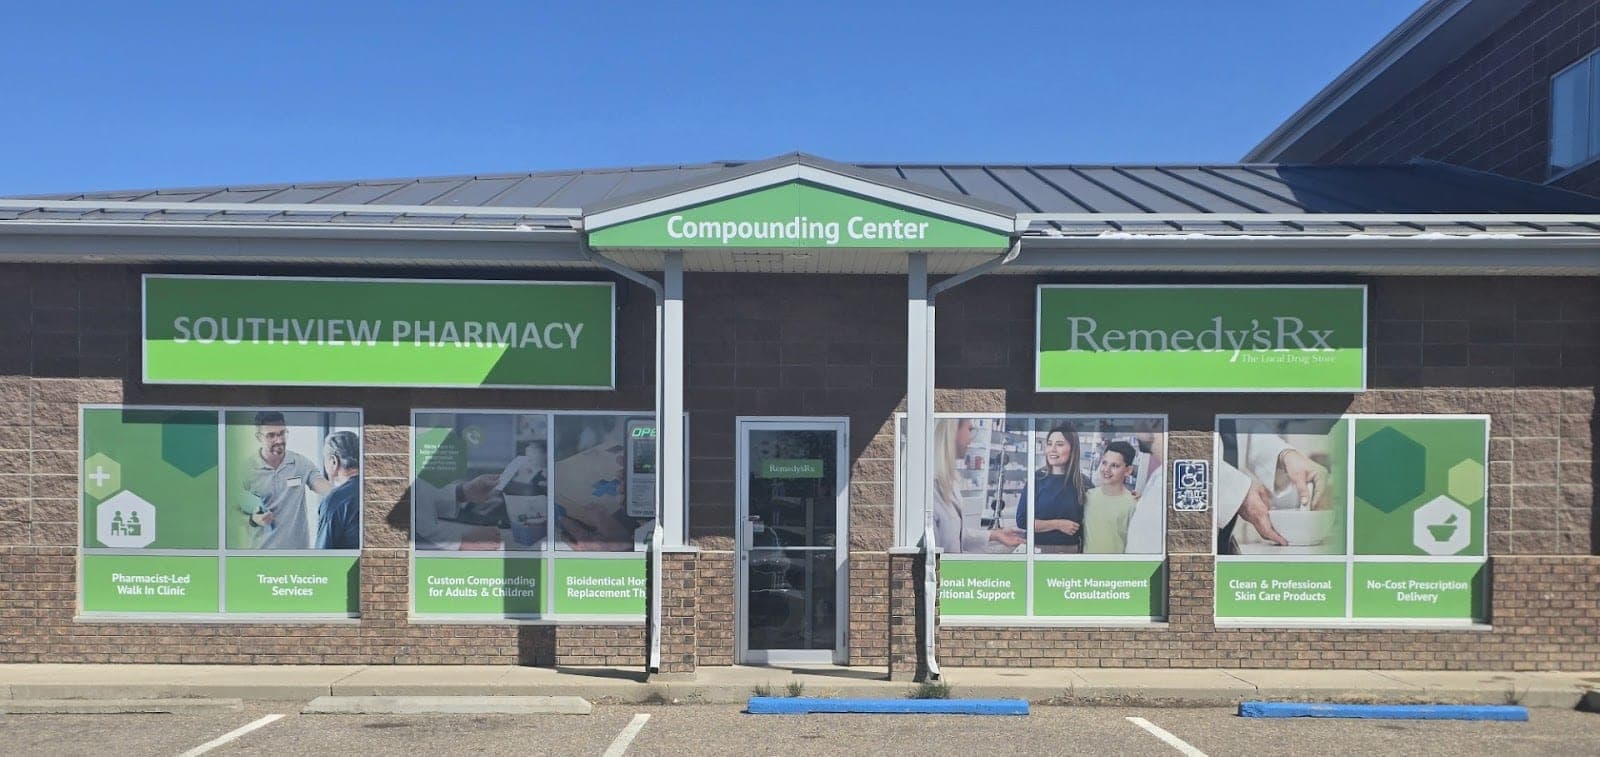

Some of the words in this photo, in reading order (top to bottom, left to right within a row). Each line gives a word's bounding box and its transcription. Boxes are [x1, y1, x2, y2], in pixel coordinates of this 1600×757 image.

[666, 215, 840, 246] Compounding
[847, 215, 929, 240] Center
[173, 316, 382, 347] SOUTHVIEW
[392, 320, 584, 350] PHARMACY
[1242, 354, 1258, 363] The
[1261, 354, 1285, 363] Local
[1287, 354, 1310, 365] Drug
[1311, 354, 1335, 363] Store
[632, 427, 657, 437] OPE
[112, 573, 191, 584] Pharmacist-Led
[257, 574, 288, 585] Travel
[290, 574, 329, 585] Vaccine
[427, 575, 465, 586] Custom
[467, 575, 536, 588] Compounding
[566, 576, 625, 587] Bioidentical
[627, 576, 648, 587] Hor
[939, 577, 965, 588] ional
[967, 577, 1011, 588] Medicine
[1047, 578, 1081, 590] Weight
[1083, 578, 1149, 591] Management
[1229, 579, 1258, 590] Clean
[1260, 579, 1269, 590] &
[1271, 579, 1332, 590] Professional
[1367, 580, 1407, 590] No-Cost
[1408, 580, 1468, 592] Prescription
[117, 585, 142, 596] Walk
[144, 585, 155, 596] In
[157, 585, 186, 596] Clinic
[272, 585, 314, 596] Services
[429, 587, 444, 598] for
[445, 587, 478, 598] Adults
[480, 587, 490, 597] &
[492, 587, 535, 598] Children
[567, 588, 630, 599] Replacement
[632, 588, 647, 598] Th
[939, 588, 974, 600] ritional
[976, 589, 1016, 601] Support
[1063, 589, 1131, 600] Consultations
[1234, 590, 1256, 602] Skin
[1258, 591, 1281, 602] Care
[1283, 590, 1327, 602] Products
[1396, 591, 1439, 603] Delivery
